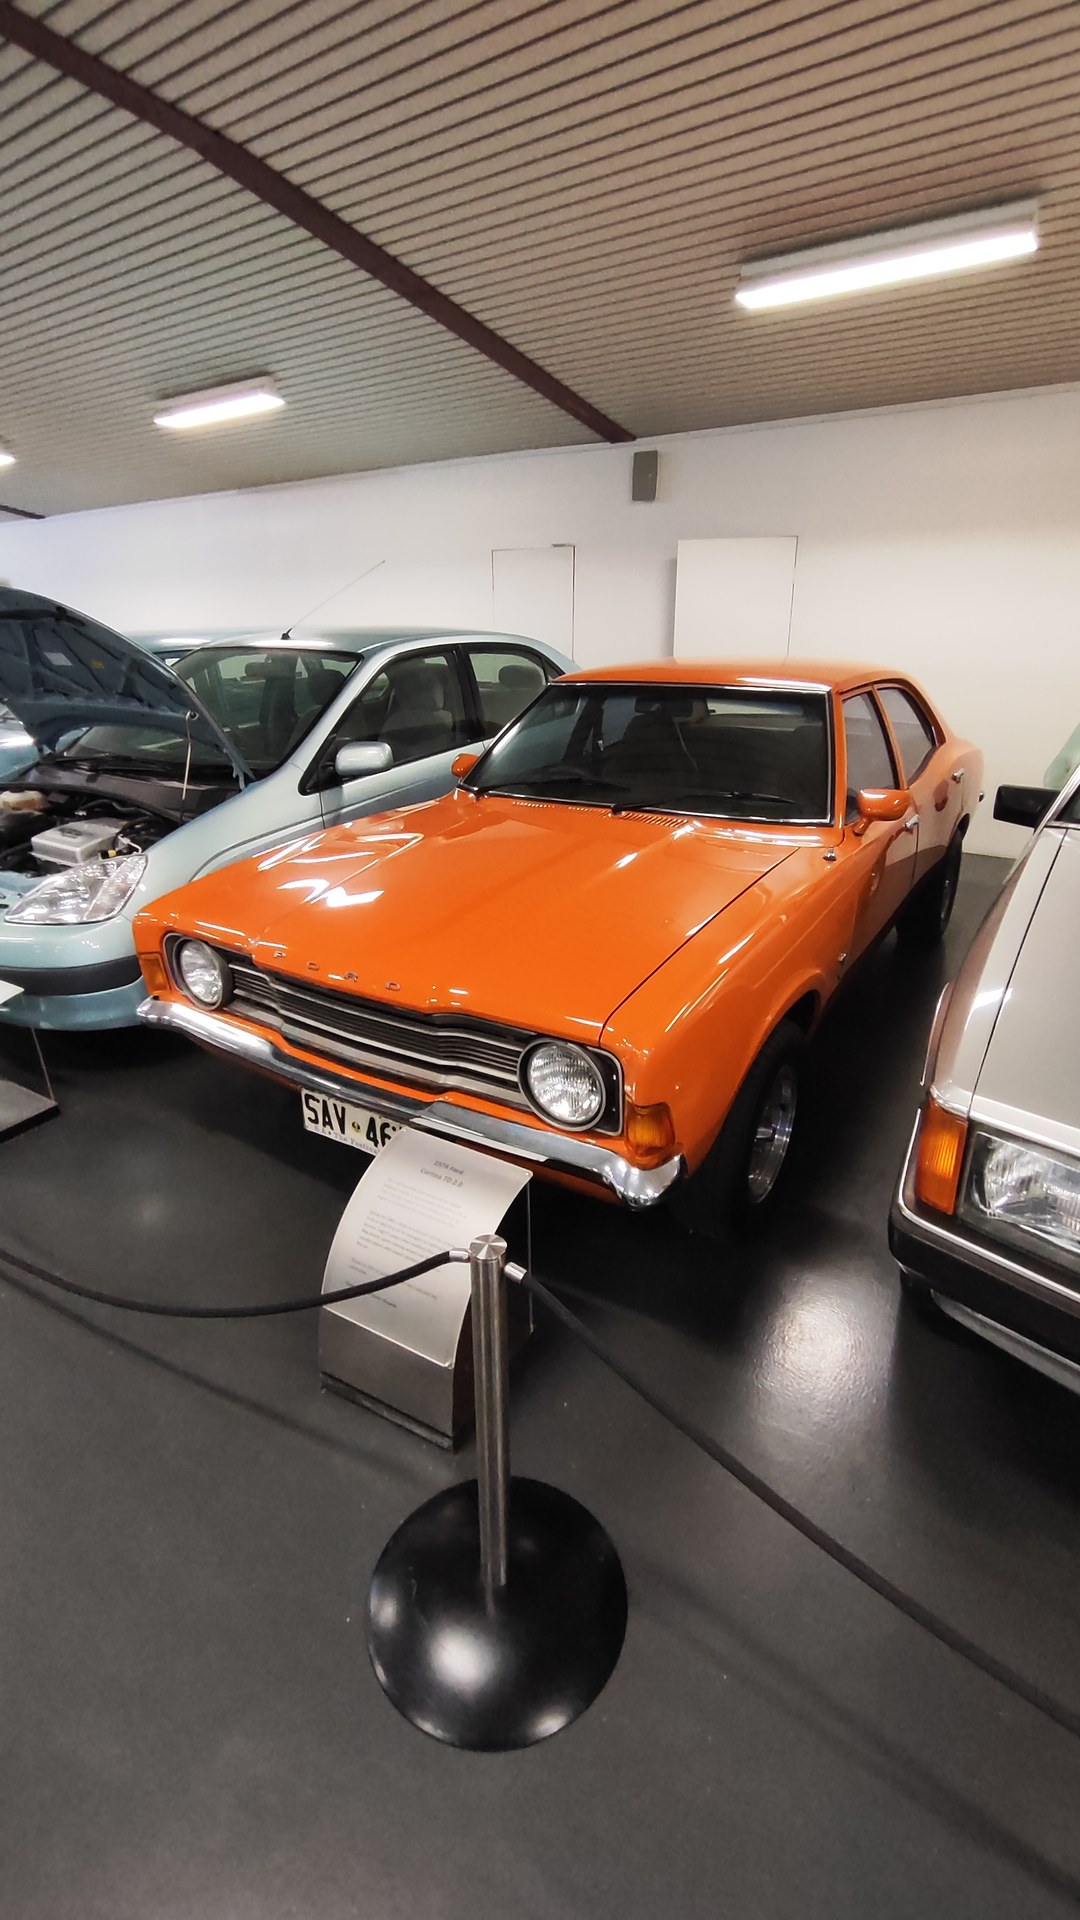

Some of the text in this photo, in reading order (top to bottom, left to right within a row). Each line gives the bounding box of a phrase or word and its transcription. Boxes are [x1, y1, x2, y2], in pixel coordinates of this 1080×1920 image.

[273, 950, 401, 991] FORD
[304, 1093, 402, 1148] SAV 46
